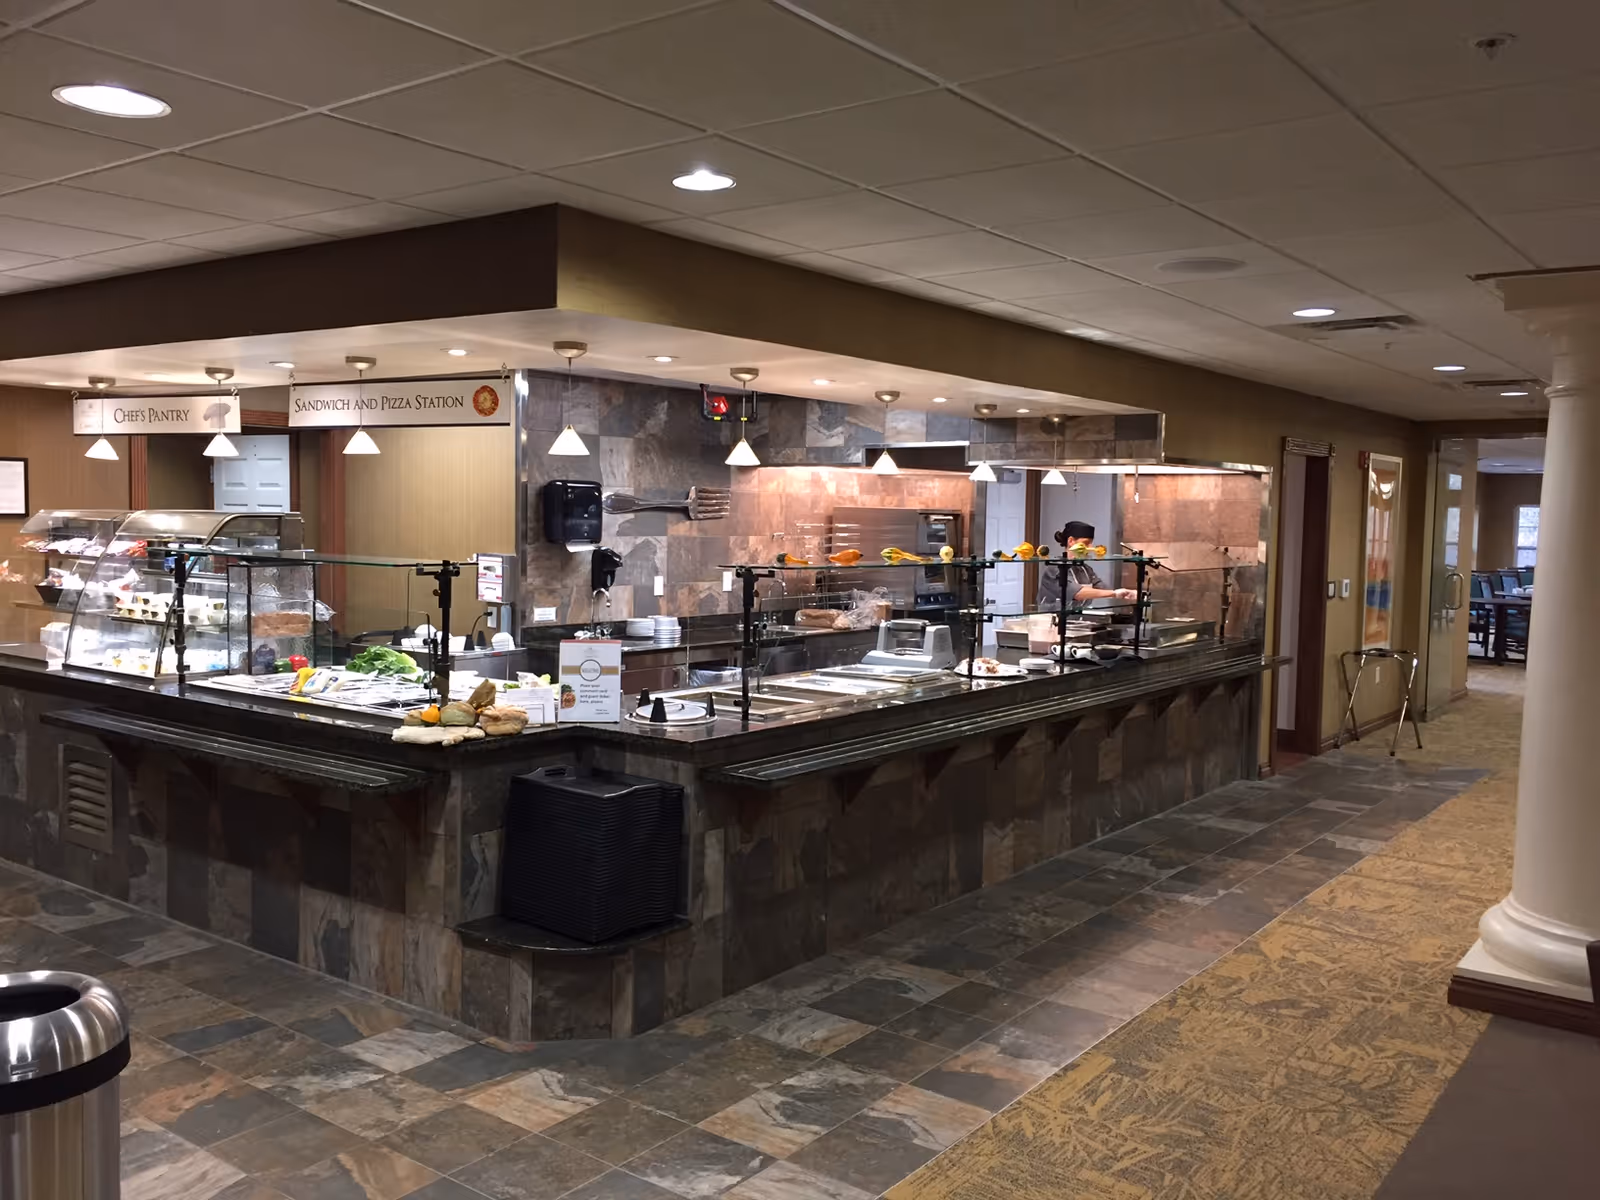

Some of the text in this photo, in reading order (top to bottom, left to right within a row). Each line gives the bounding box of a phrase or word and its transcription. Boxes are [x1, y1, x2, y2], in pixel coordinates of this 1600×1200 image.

[295, 394, 464, 413] SANDWICH AND PIZZA STATION
[113, 407, 146, 424] CHEF'S
[148, 407, 190, 423] PANTRY
